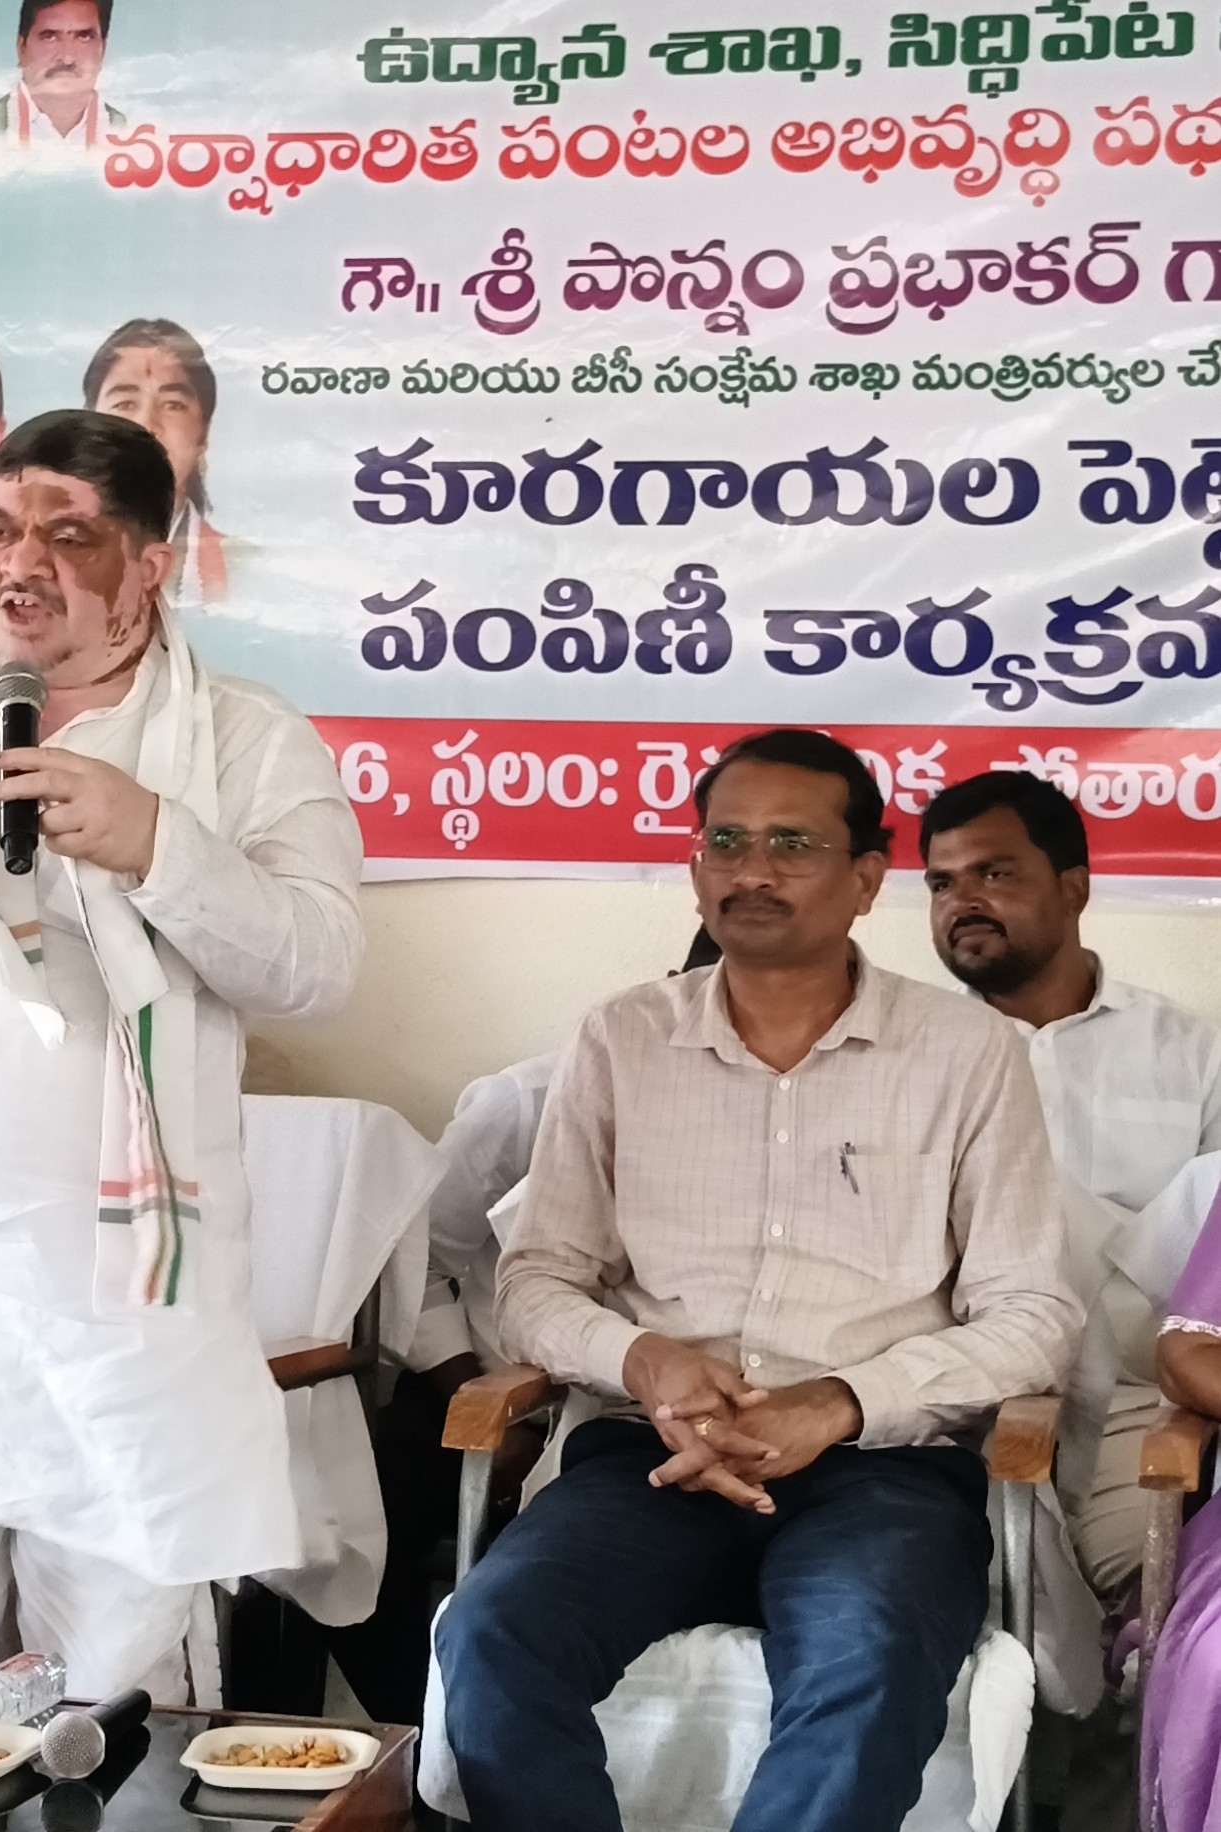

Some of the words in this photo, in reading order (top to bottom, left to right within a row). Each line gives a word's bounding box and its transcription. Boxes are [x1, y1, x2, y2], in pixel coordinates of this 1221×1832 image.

[357, 23, 626, 106] ఉద్యాన
[649, 23, 862, 82] శాఖ,
[888, 0, 1194, 98] సిద్ధిపేట
[104, 119, 478, 215] వర్షాధారిత
[498, 109, 749, 179] పంటల
[771, 104, 1071, 207] అభివృద్ధి
[461, 228, 541, 336] శ్రీ
[563, 239, 804, 336] పొన్నం
[825, 221, 1141, 335] ప్రభాకర్
[262, 359, 391, 395] రవాణా
[401, 358, 560, 395] మరియు
[571, 346, 643, 395] బీసీ
[655, 346, 797, 408] సంక్షేమ
[809, 358, 900, 400] శాఖ
[912, 352, 1165, 404] మంత్రివర్యుల
[353, 436, 1040, 527] కూరగాయల
[360, 563, 733, 677] పంపిణీ
[431, 729, 619, 851] స్థలం:
